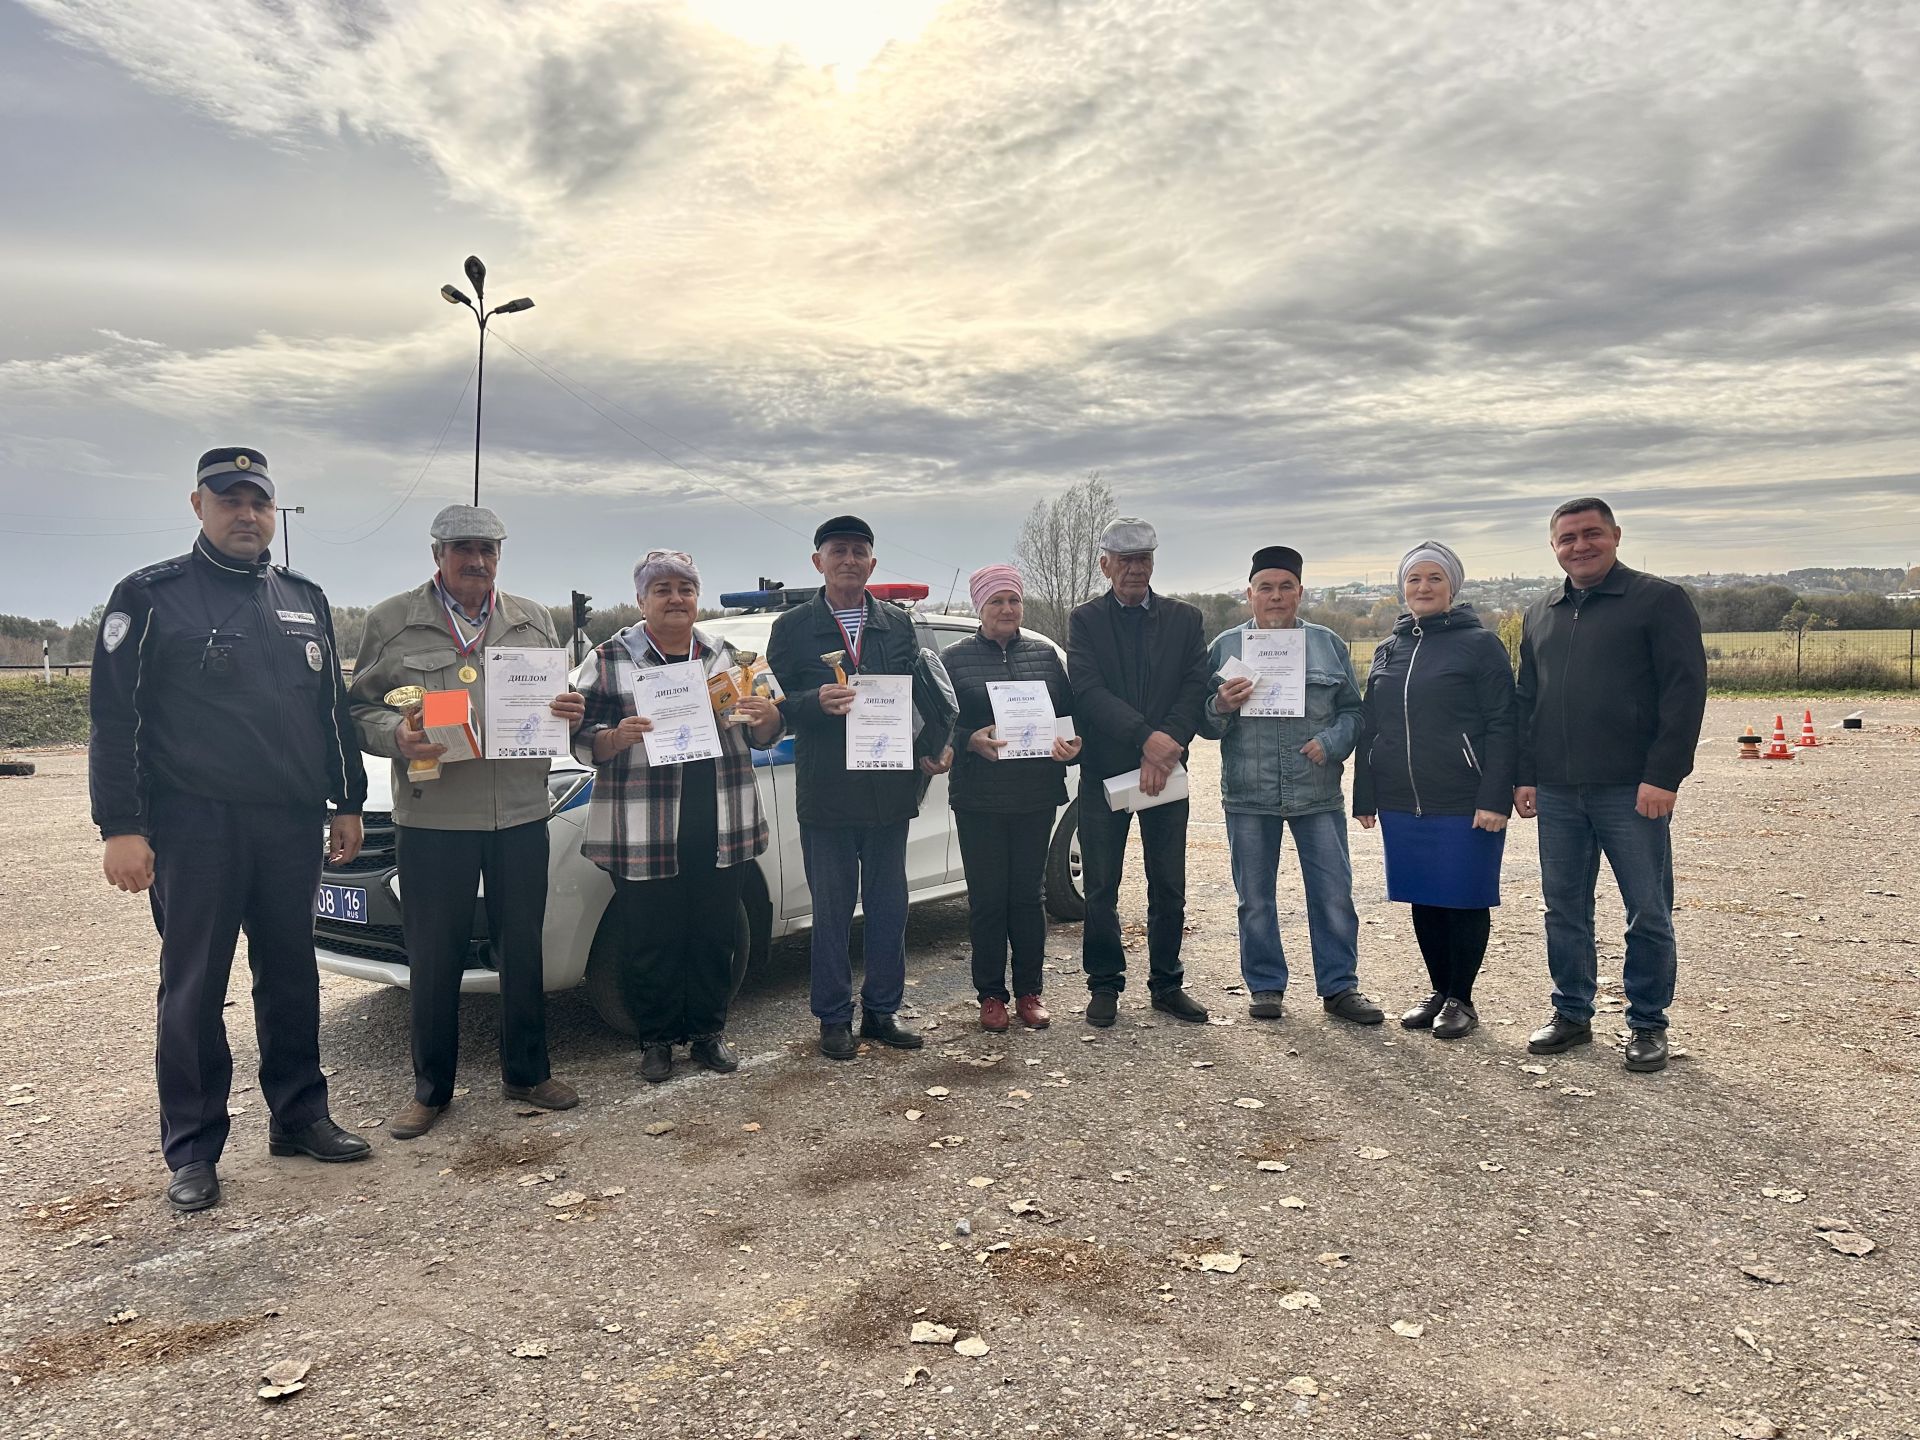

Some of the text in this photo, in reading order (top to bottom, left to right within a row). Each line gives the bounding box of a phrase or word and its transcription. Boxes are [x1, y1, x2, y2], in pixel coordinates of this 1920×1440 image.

[508, 674, 547, 683] ДИПЛОМ
[654, 686, 689, 698] ДИПЛОМ
[864, 697, 895, 705] ДИПЛОМ
[318, 888, 360, 914] 08 16
[346, 910, 359, 919] RUS
